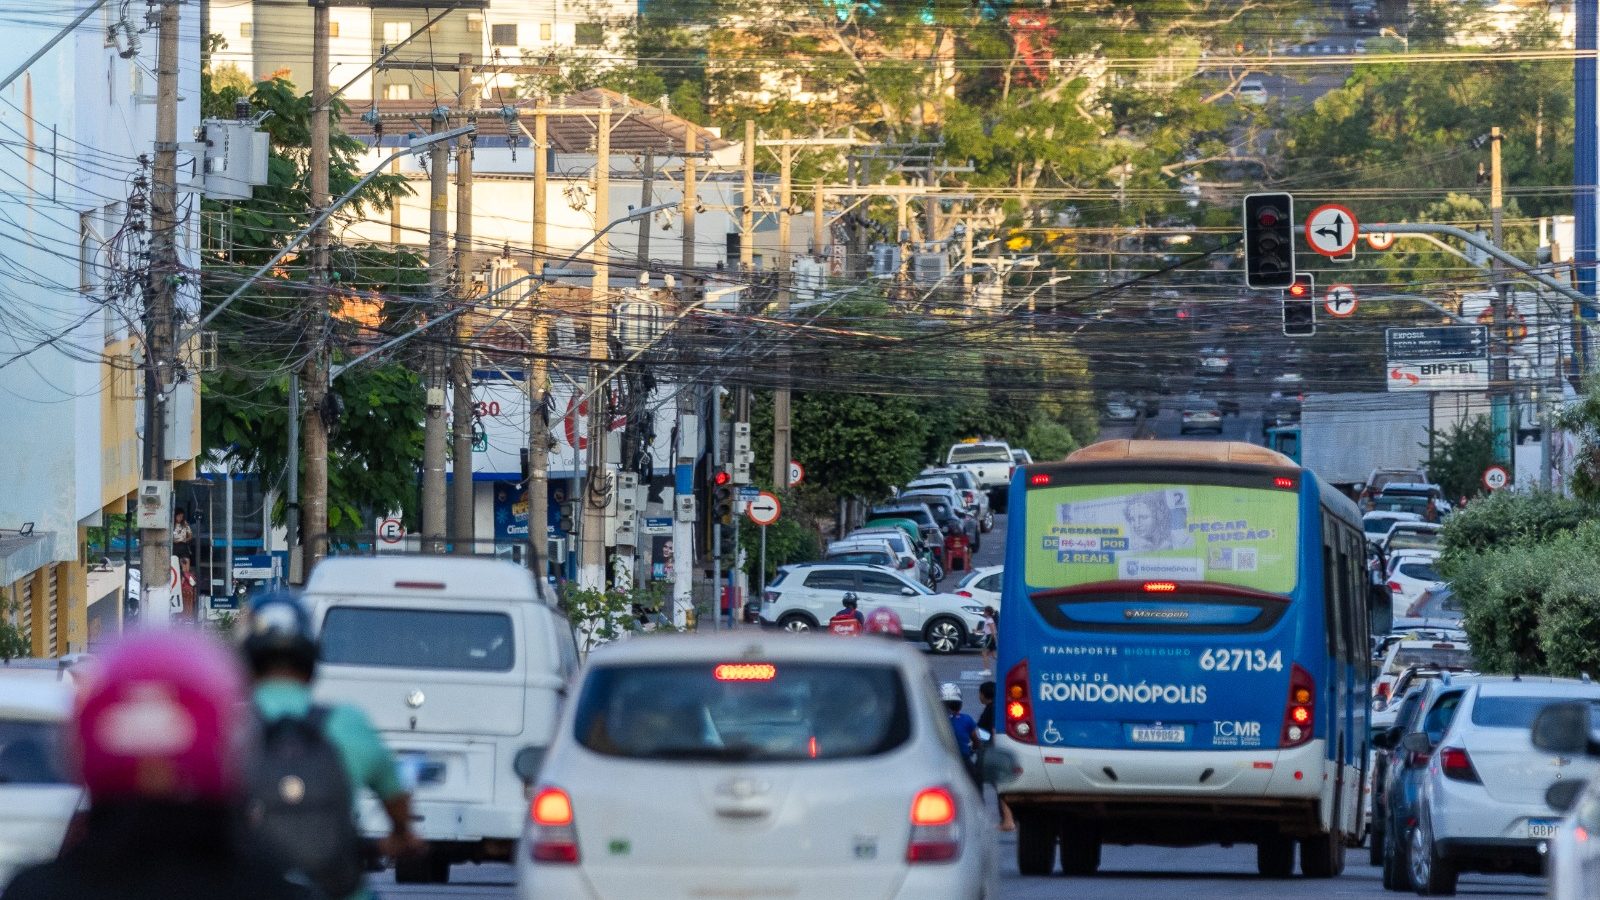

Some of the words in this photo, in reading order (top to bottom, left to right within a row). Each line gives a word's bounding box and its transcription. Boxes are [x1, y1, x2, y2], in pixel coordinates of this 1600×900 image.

[1421, 363, 1478, 375] BIPTEL
[1490, 474, 1503, 483] 40
[1173, 492, 1184, 506] 2
[388, 525, 395, 537] E
[1063, 554, 1069, 562] 2
[1073, 553, 1110, 563] REAIS
[1134, 610, 1189, 619] Marcopolo
[1042, 646, 1118, 655] TRANSPORTE
[1200, 648, 1283, 672] 627134
[1042, 673, 1088, 682] CIDADE
[1095, 673, 1109, 682] DE
[1040, 680, 1207, 704] RONDONÓPOLIS
[1213, 720, 1261, 737] TCMR
